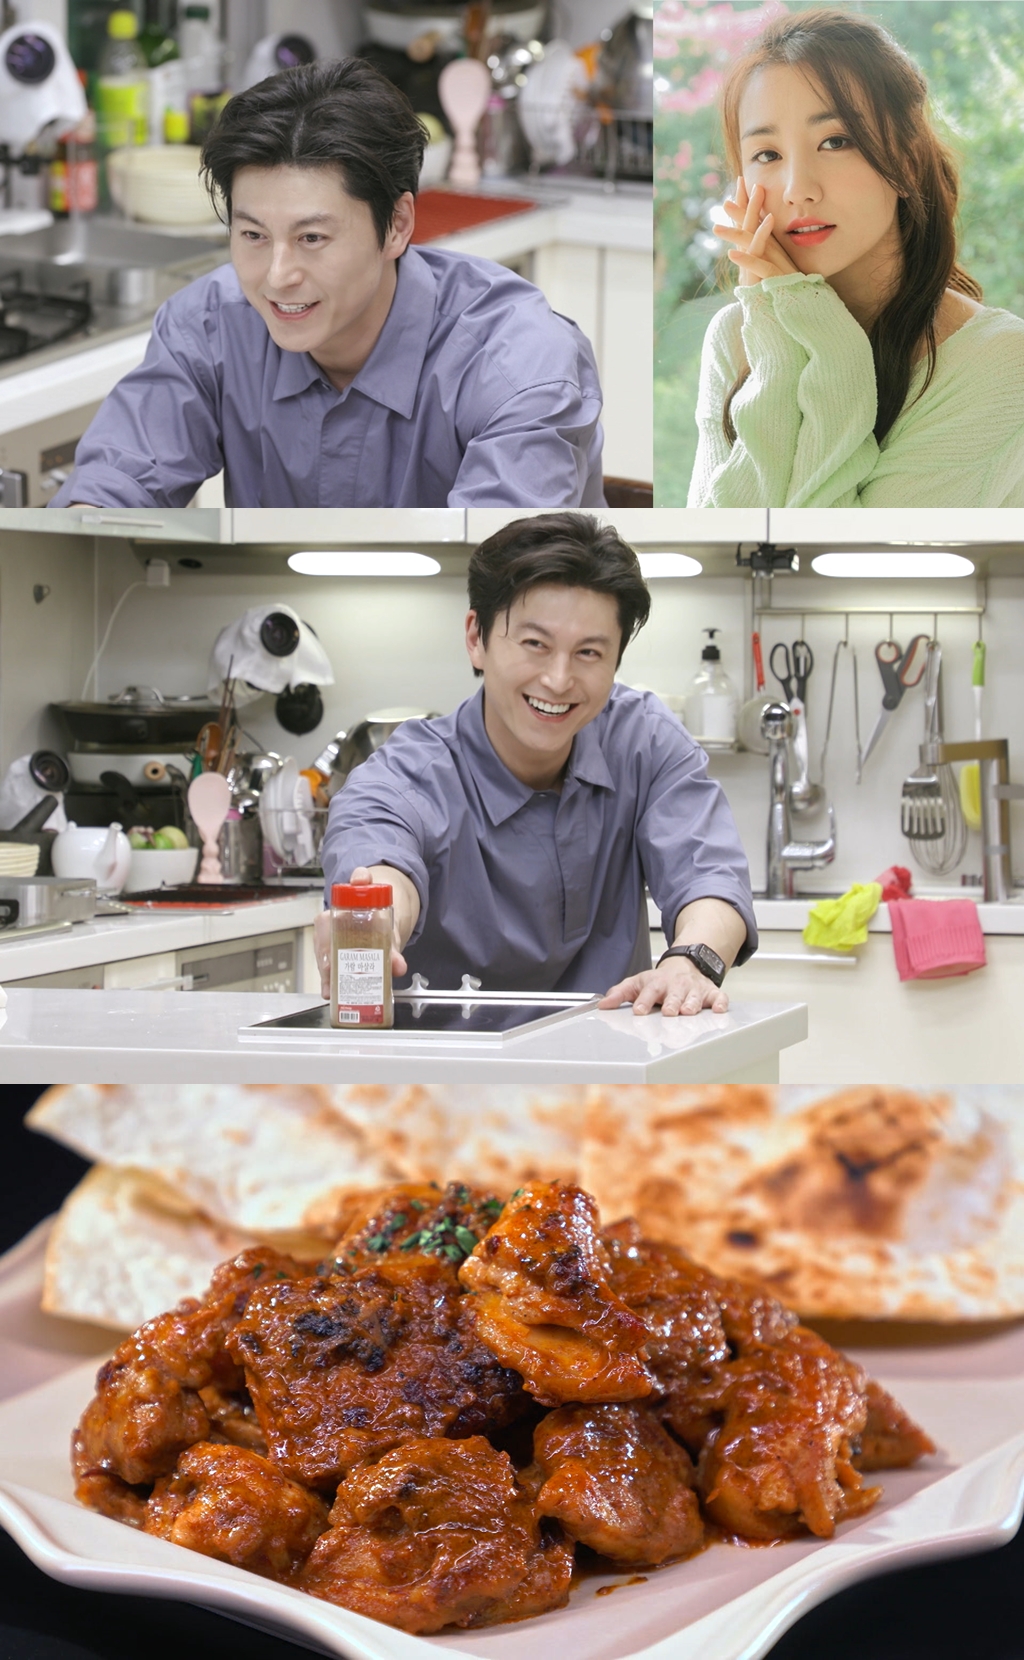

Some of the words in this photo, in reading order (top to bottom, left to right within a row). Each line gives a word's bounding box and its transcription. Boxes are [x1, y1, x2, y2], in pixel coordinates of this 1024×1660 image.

[340, 952, 359, 961] GARAM
[359, 952, 380, 961] MASALA
[357, 962, 375, 972] 마살라
